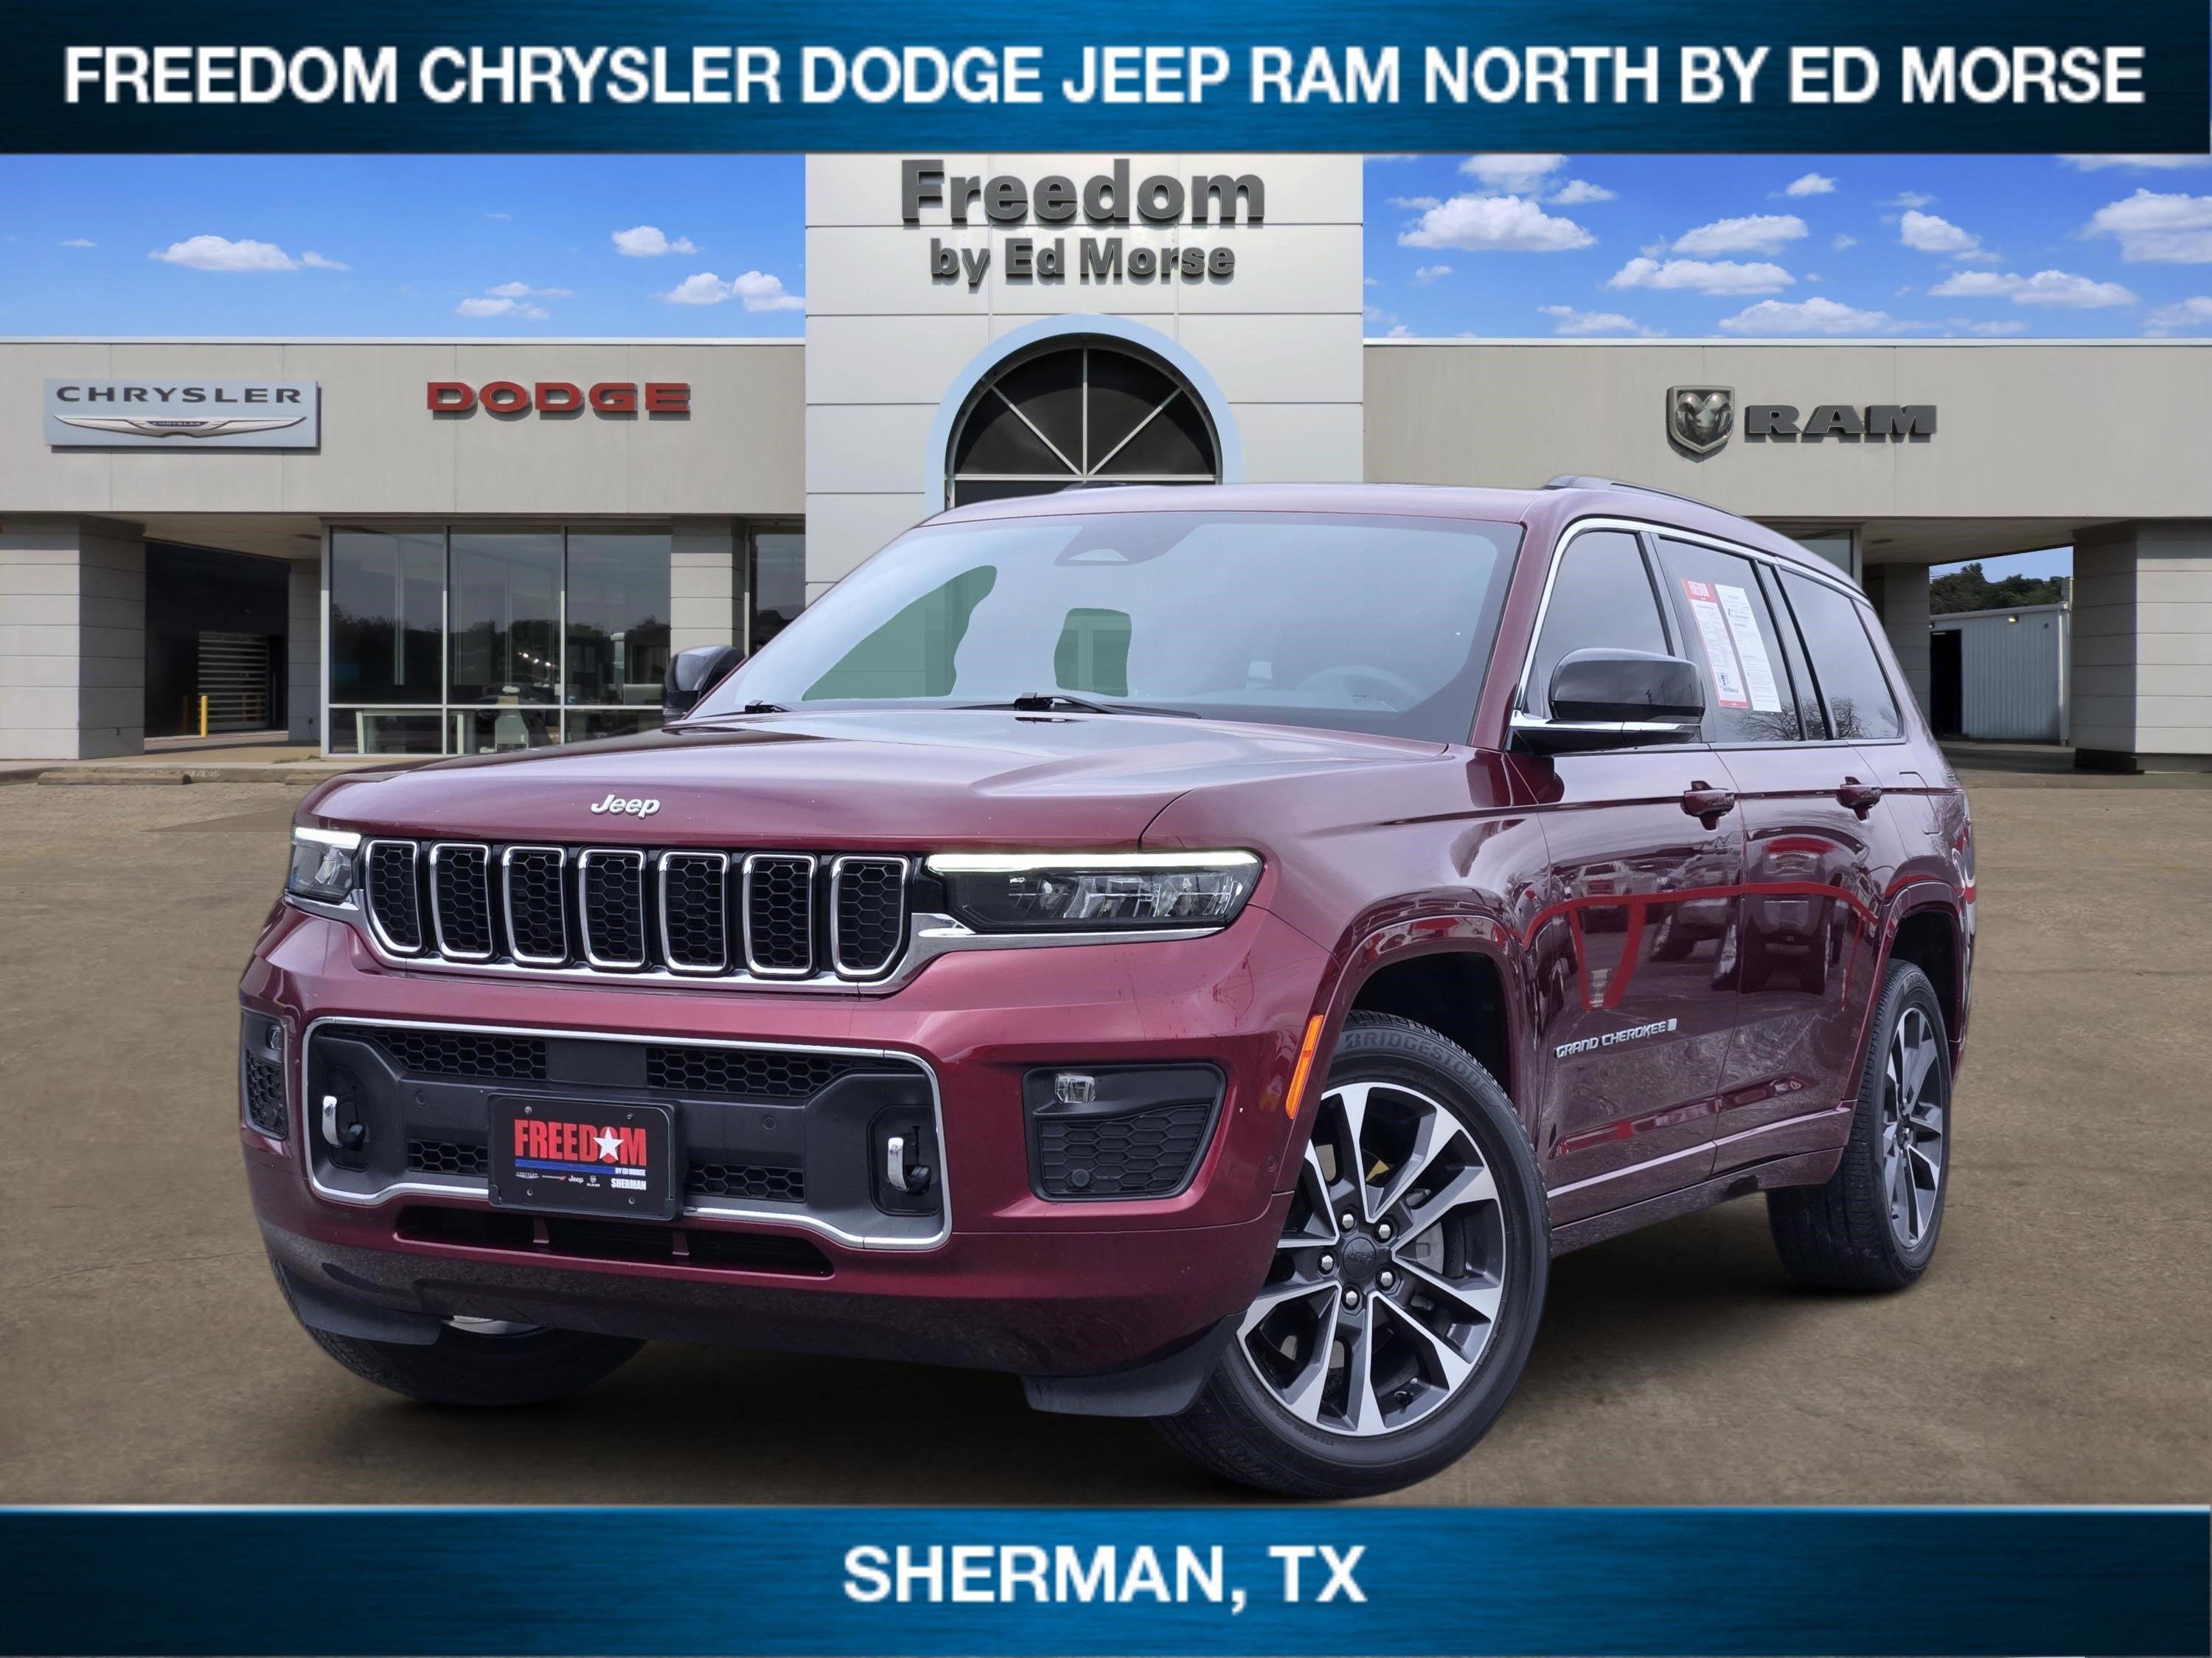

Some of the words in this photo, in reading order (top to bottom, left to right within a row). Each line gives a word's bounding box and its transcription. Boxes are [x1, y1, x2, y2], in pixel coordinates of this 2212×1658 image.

[901, 158, 1265, 223] Freedom
[930, 237, 991, 286] by
[1004, 237, 1066, 276] Ed
[1079, 237, 1237, 277] Morse
[55, 385, 303, 404] CHRYSLER
[426, 381, 692, 413] DODGE
[1745, 404, 1938, 437] RAM
[591, 794, 661, 819] Jeep
[1555, 1036, 1599, 1059] GRAND
[1601, 1021, 1667, 1047] CHEROKEE
[1344, 1032, 1495, 1097] BRIDGESTONE
[514, 1119, 647, 1166] FREEDOM
[568, 1175, 585, 1184] Jeep
[611, 1178, 647, 1190] SHERMAN
